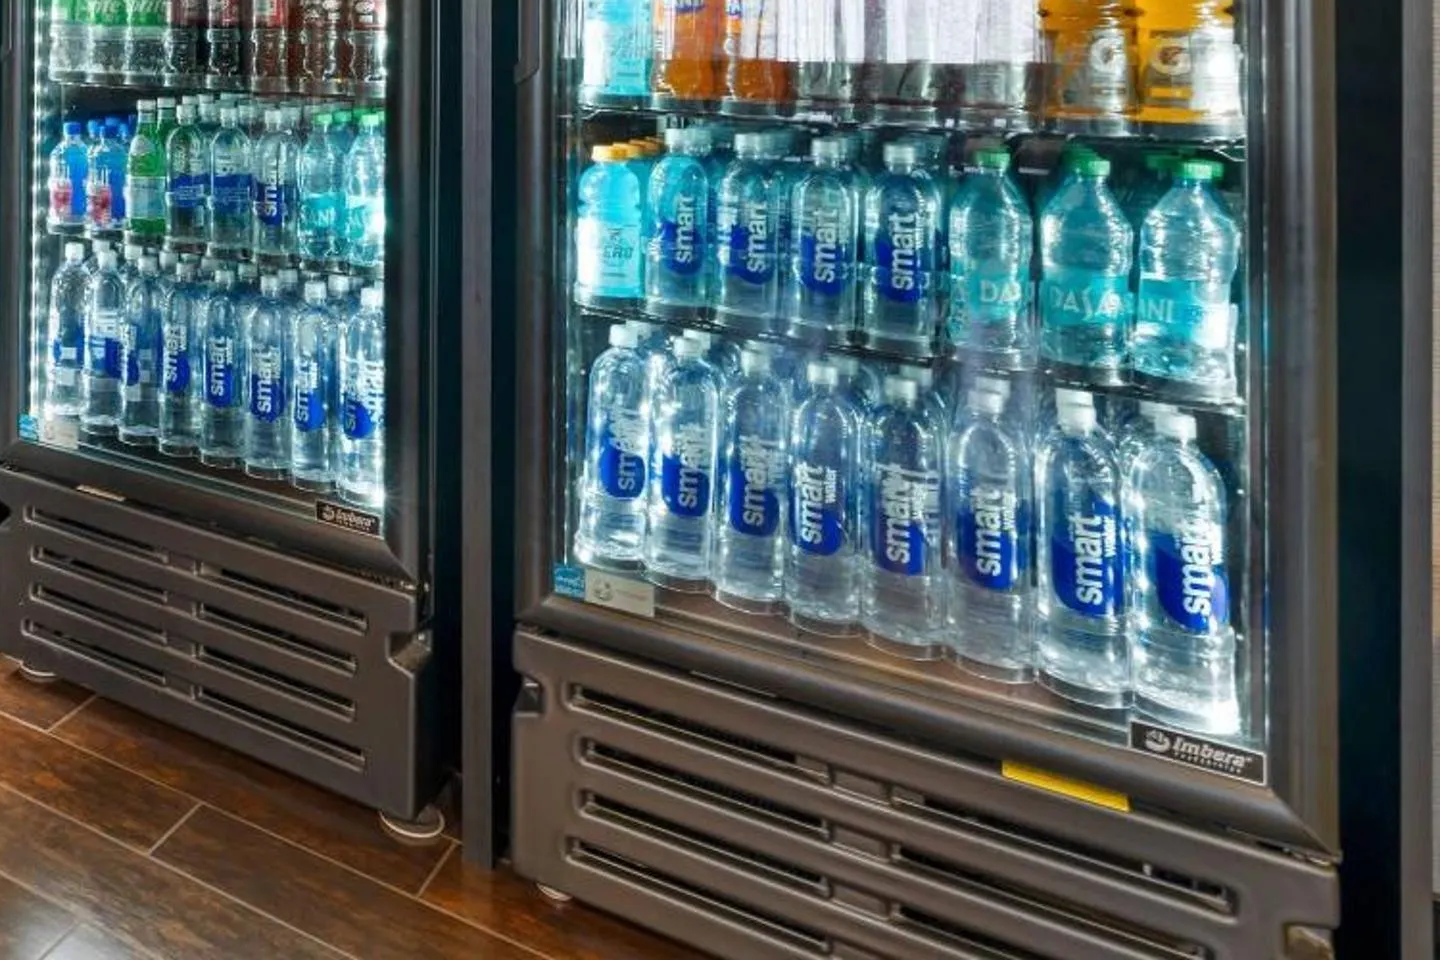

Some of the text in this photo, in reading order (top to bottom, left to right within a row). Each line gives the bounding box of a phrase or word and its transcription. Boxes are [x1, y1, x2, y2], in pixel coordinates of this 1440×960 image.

[675, 196, 696, 265] smart
[746, 202, 769, 274] smart
[814, 207, 838, 284] smart
[889, 212, 916, 291] smart
[209, 336, 226, 397] smart
[797, 461, 824, 545] smart
[824, 469, 838, 504] water
[884, 467, 913, 566] smart
[1001, 492, 1018, 532] water
[975, 487, 1002, 578] smart
[1071, 512, 1103, 608] smart
[1102, 516, 1118, 558] water
[1180, 518, 1214, 618] smart
[1172, 736, 1245, 768] Imbera
